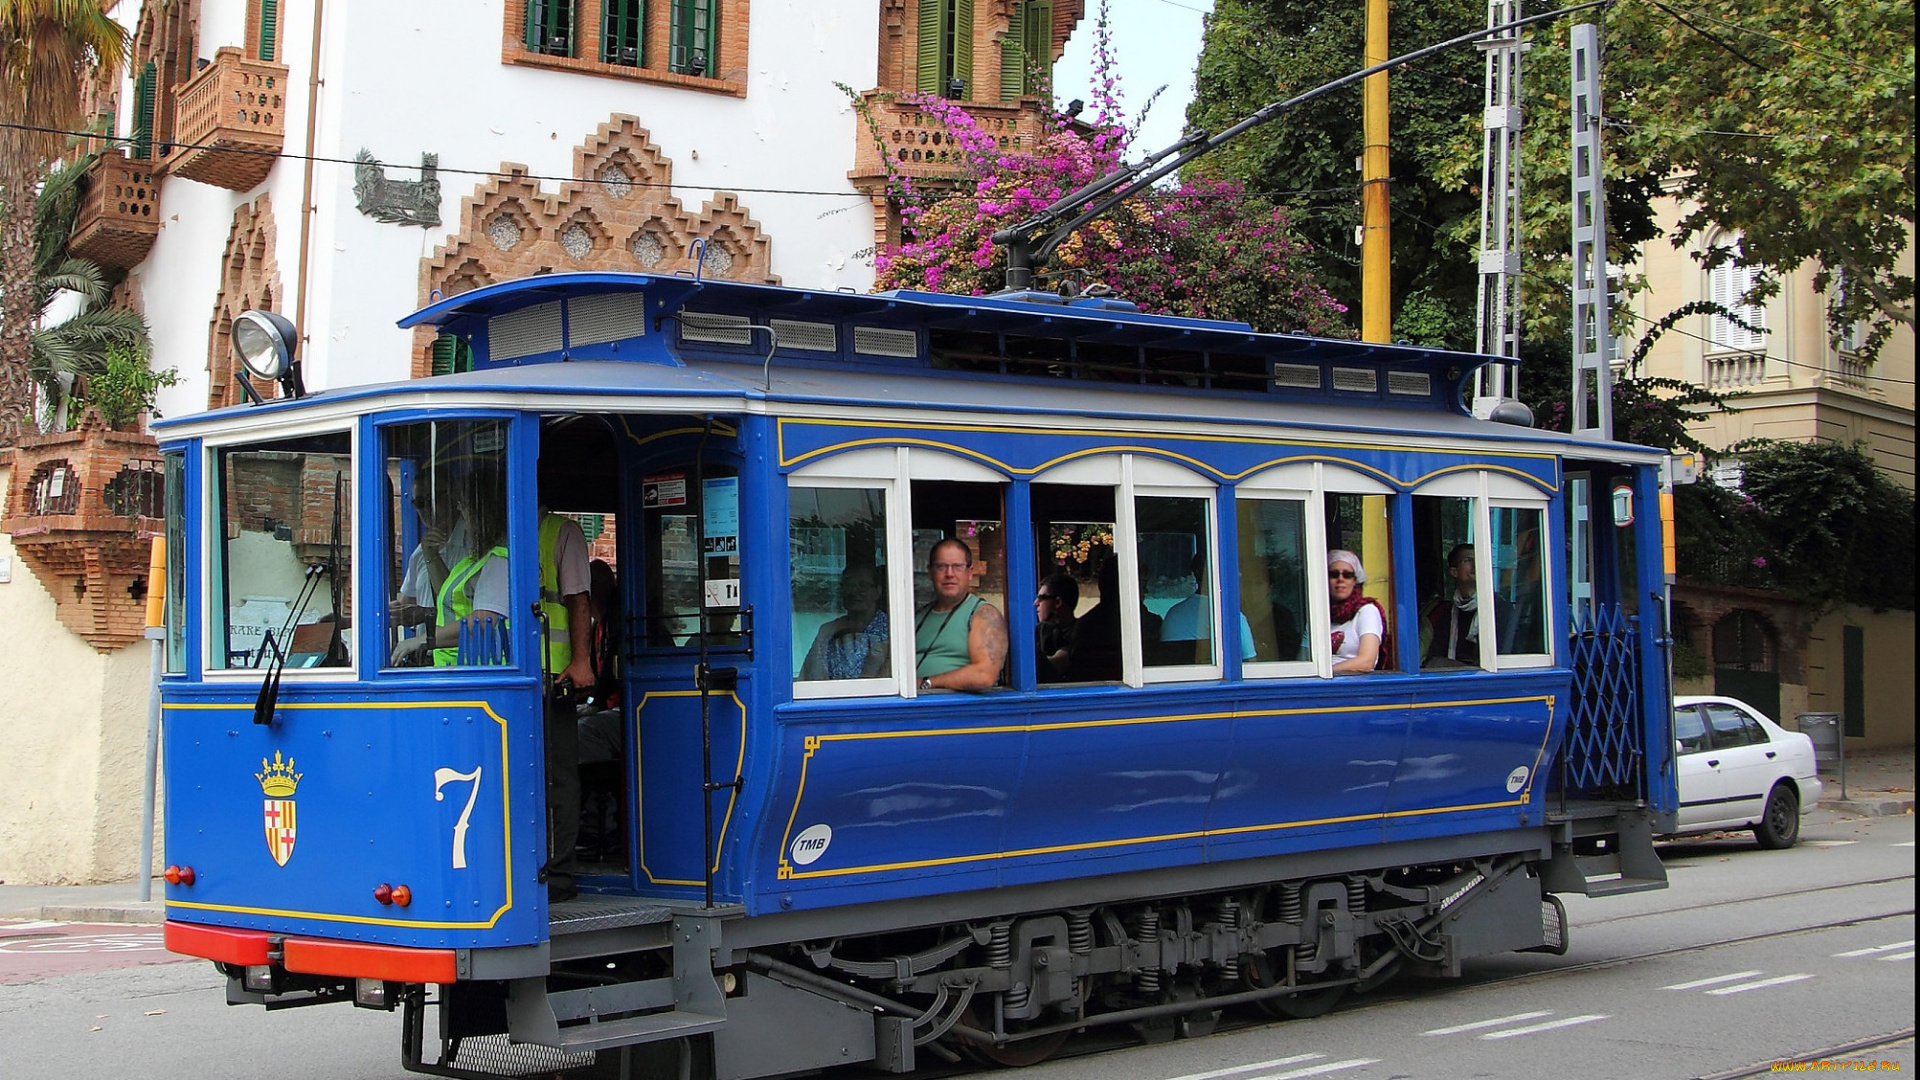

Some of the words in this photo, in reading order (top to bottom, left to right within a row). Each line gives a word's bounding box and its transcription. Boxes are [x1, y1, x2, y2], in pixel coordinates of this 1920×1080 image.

[1511, 775, 1525, 784] TMB
[434, 766, 482, 869] 7
[799, 838, 826, 851] TMB
